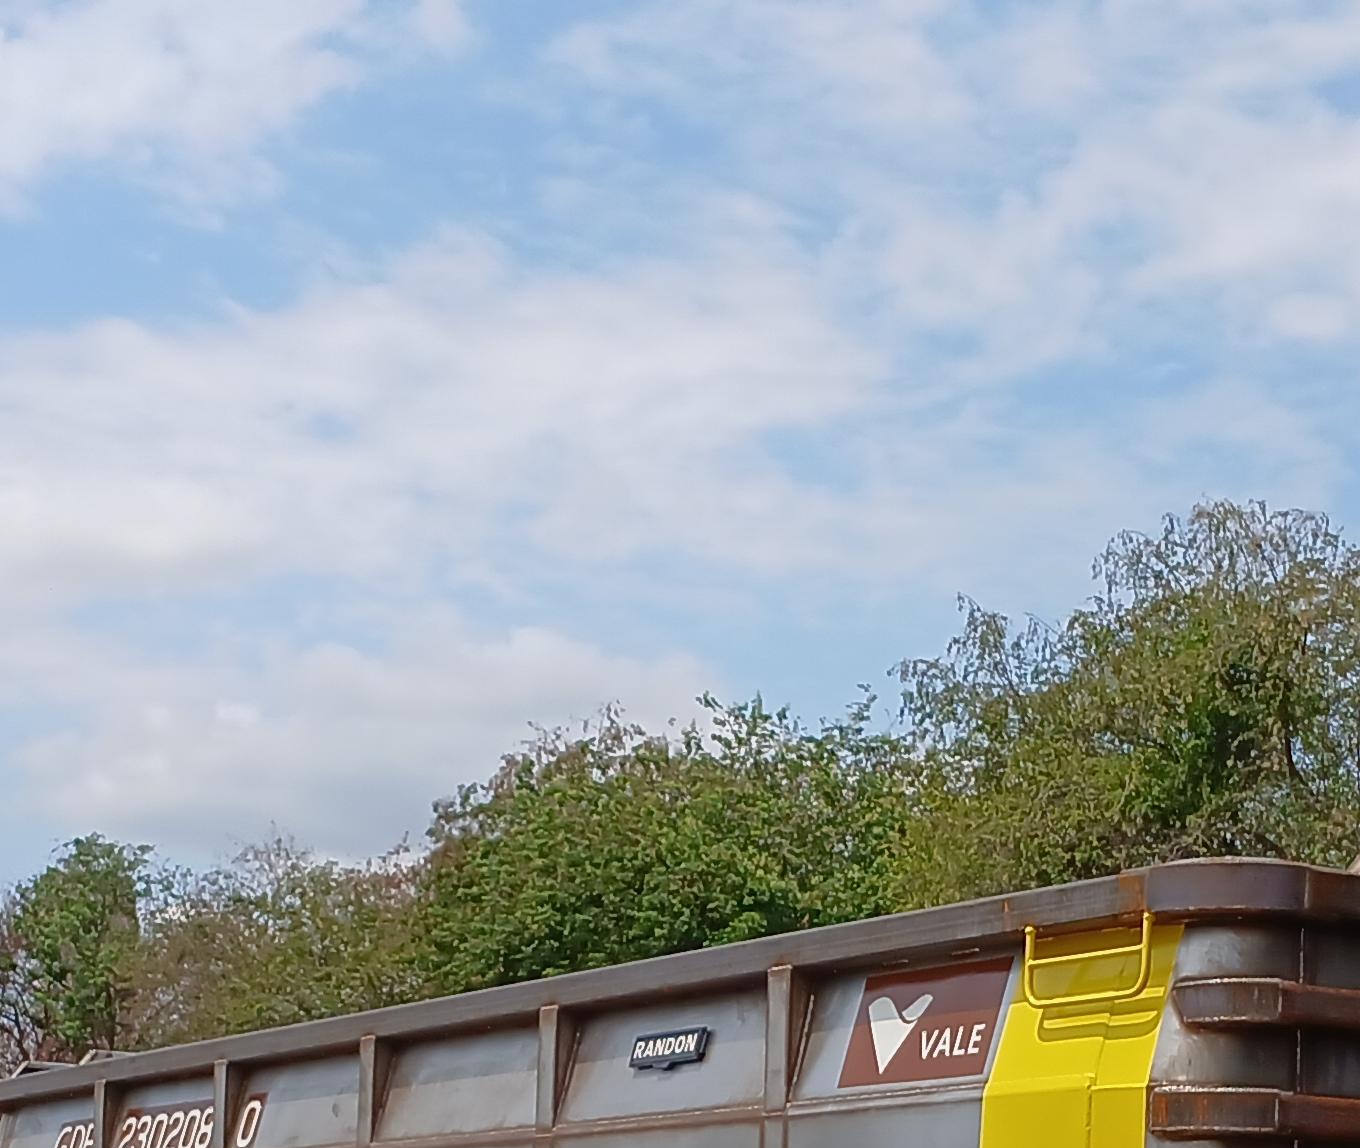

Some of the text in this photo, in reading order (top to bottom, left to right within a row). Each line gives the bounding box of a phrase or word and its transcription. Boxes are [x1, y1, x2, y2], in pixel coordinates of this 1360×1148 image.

[633, 1032, 698, 1059] RANDON
[921, 1023, 986, 1060] VALE
[236, 1100, 261, 1148] 0
